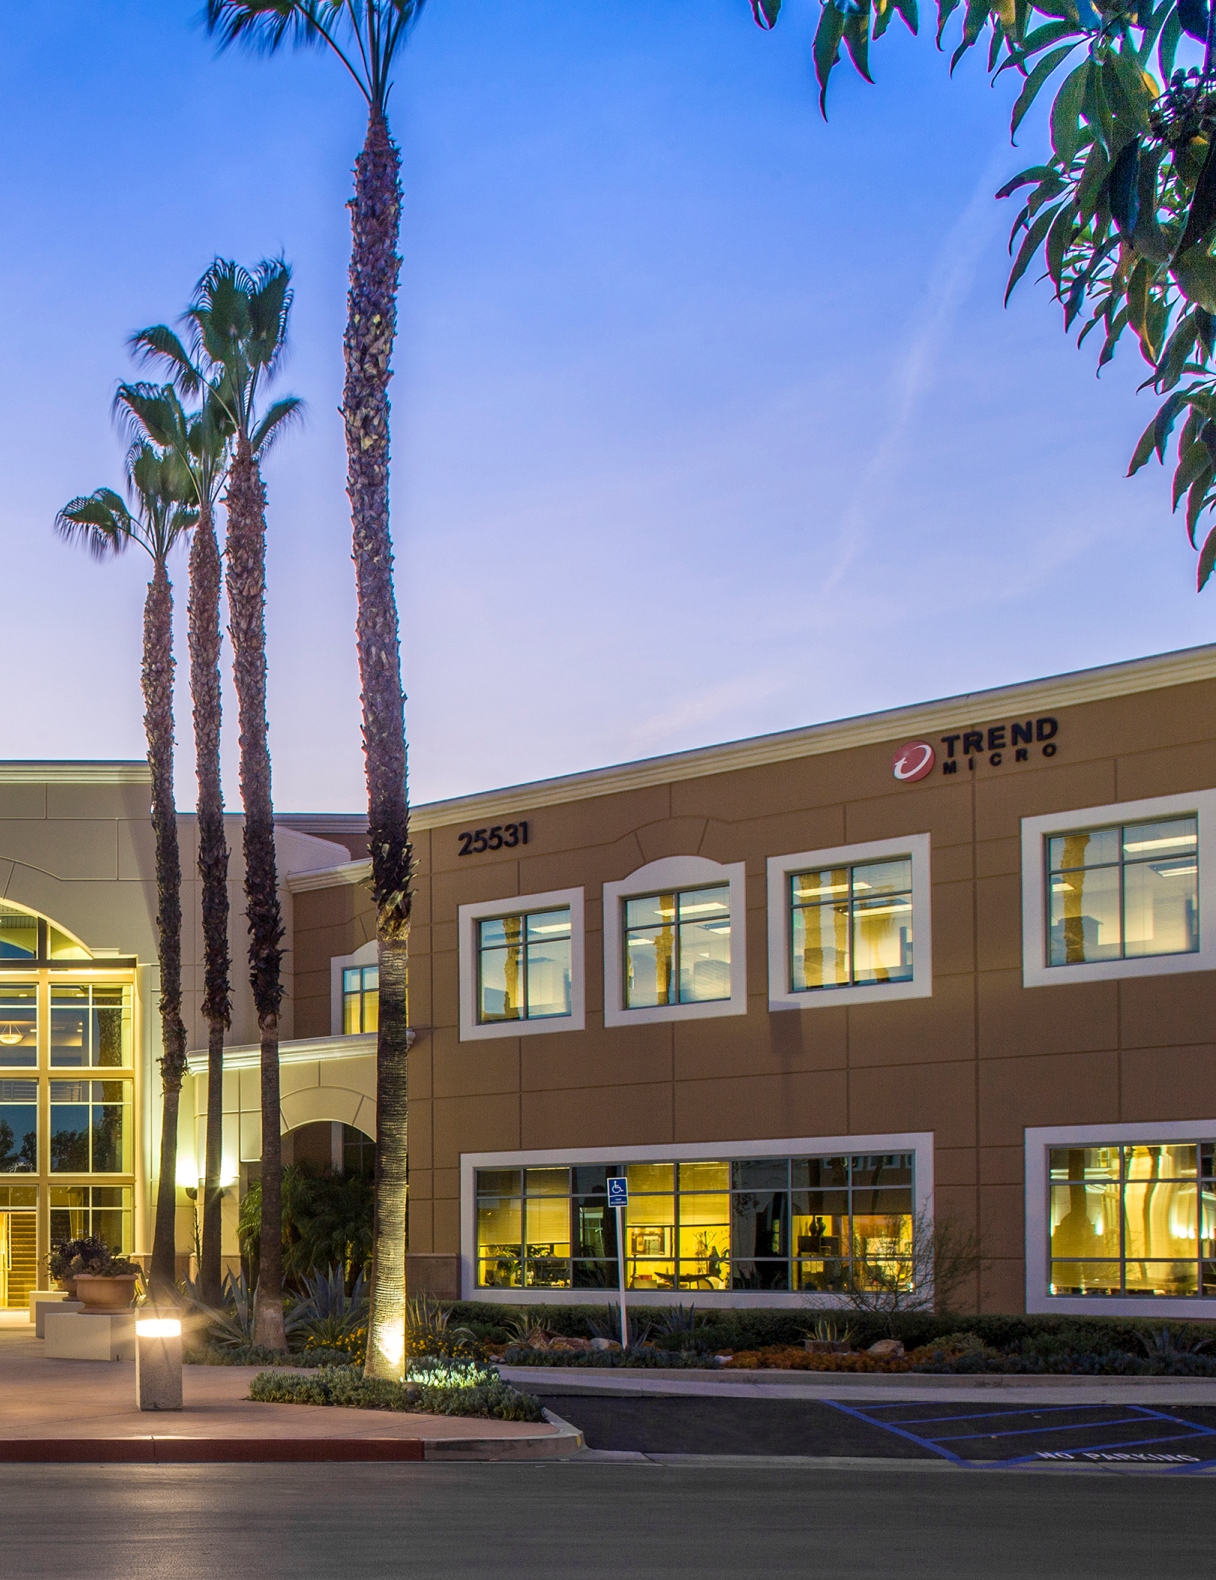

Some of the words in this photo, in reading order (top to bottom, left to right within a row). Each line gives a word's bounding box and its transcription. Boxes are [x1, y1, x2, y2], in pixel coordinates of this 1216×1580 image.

[941, 717, 1059, 758] TREND
[942, 743, 1057, 775] MICRO
[458, 821, 528, 856] 25531
[1034, 1451, 1075, 1460] NO
[1082, 1453, 1200, 1463] PARKING
